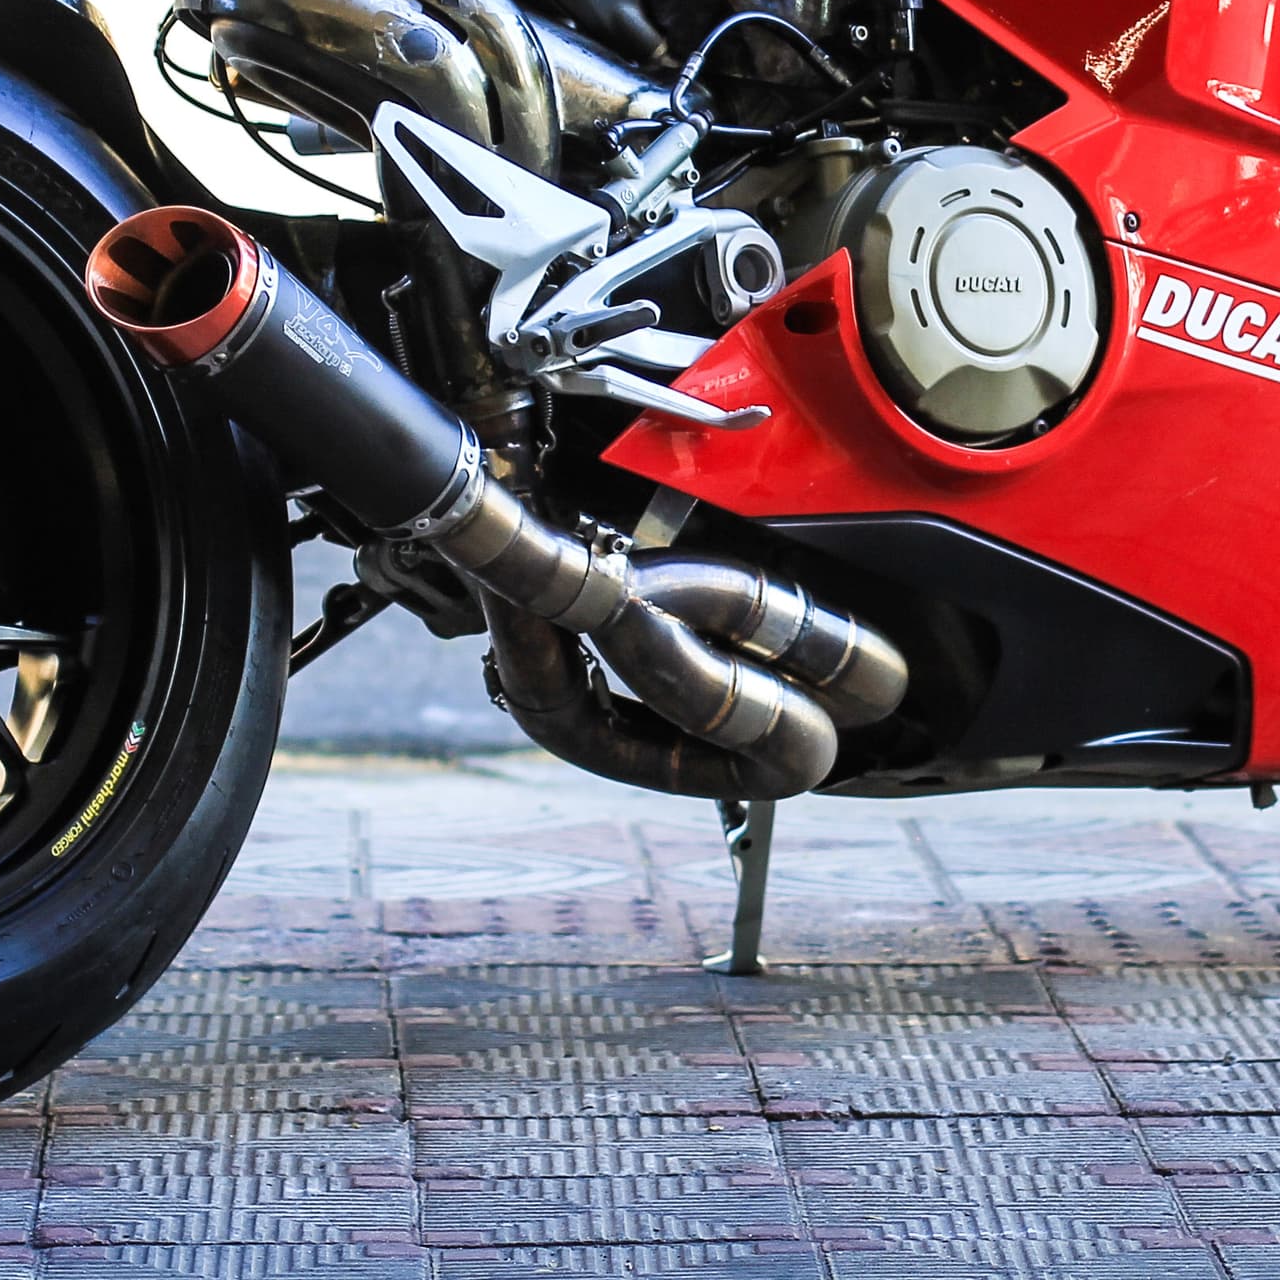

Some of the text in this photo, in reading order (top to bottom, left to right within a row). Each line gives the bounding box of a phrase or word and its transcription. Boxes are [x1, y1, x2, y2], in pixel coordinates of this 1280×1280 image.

[955, 276, 1023, 294] DUCATI
[80, 751, 130, 829] marchesini
[50, 821, 83, 858] FORGED
